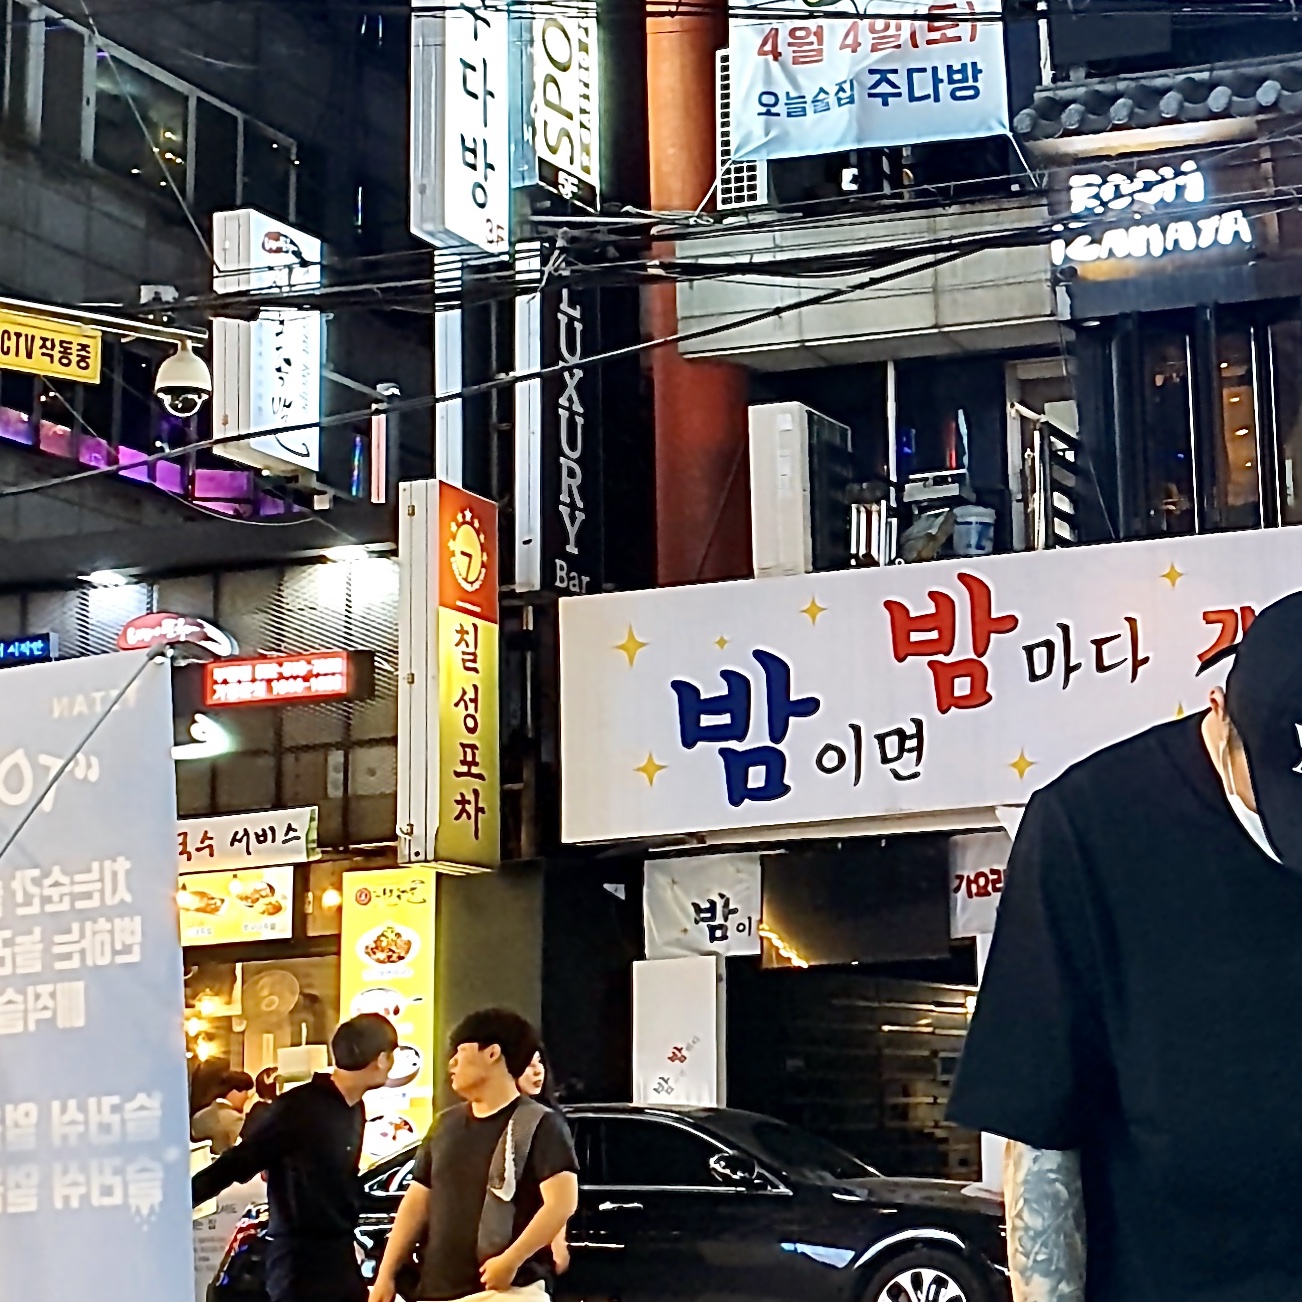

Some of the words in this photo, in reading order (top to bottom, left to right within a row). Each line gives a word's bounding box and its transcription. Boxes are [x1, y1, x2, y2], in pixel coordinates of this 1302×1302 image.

[757, 25, 824, 66] 4월
[757, 79, 856, 118] 오늘술집
[867, 61, 983, 107] 주다방
[556, 262, 585, 555] LUXURY
[554, 558, 590, 595] Bar
[883, 572, 1149, 715] 밤마다
[453, 622, 487, 841] 칠성포차
[671, 648, 925, 808] 밤이면
[229, 822, 302, 856] 서비스
